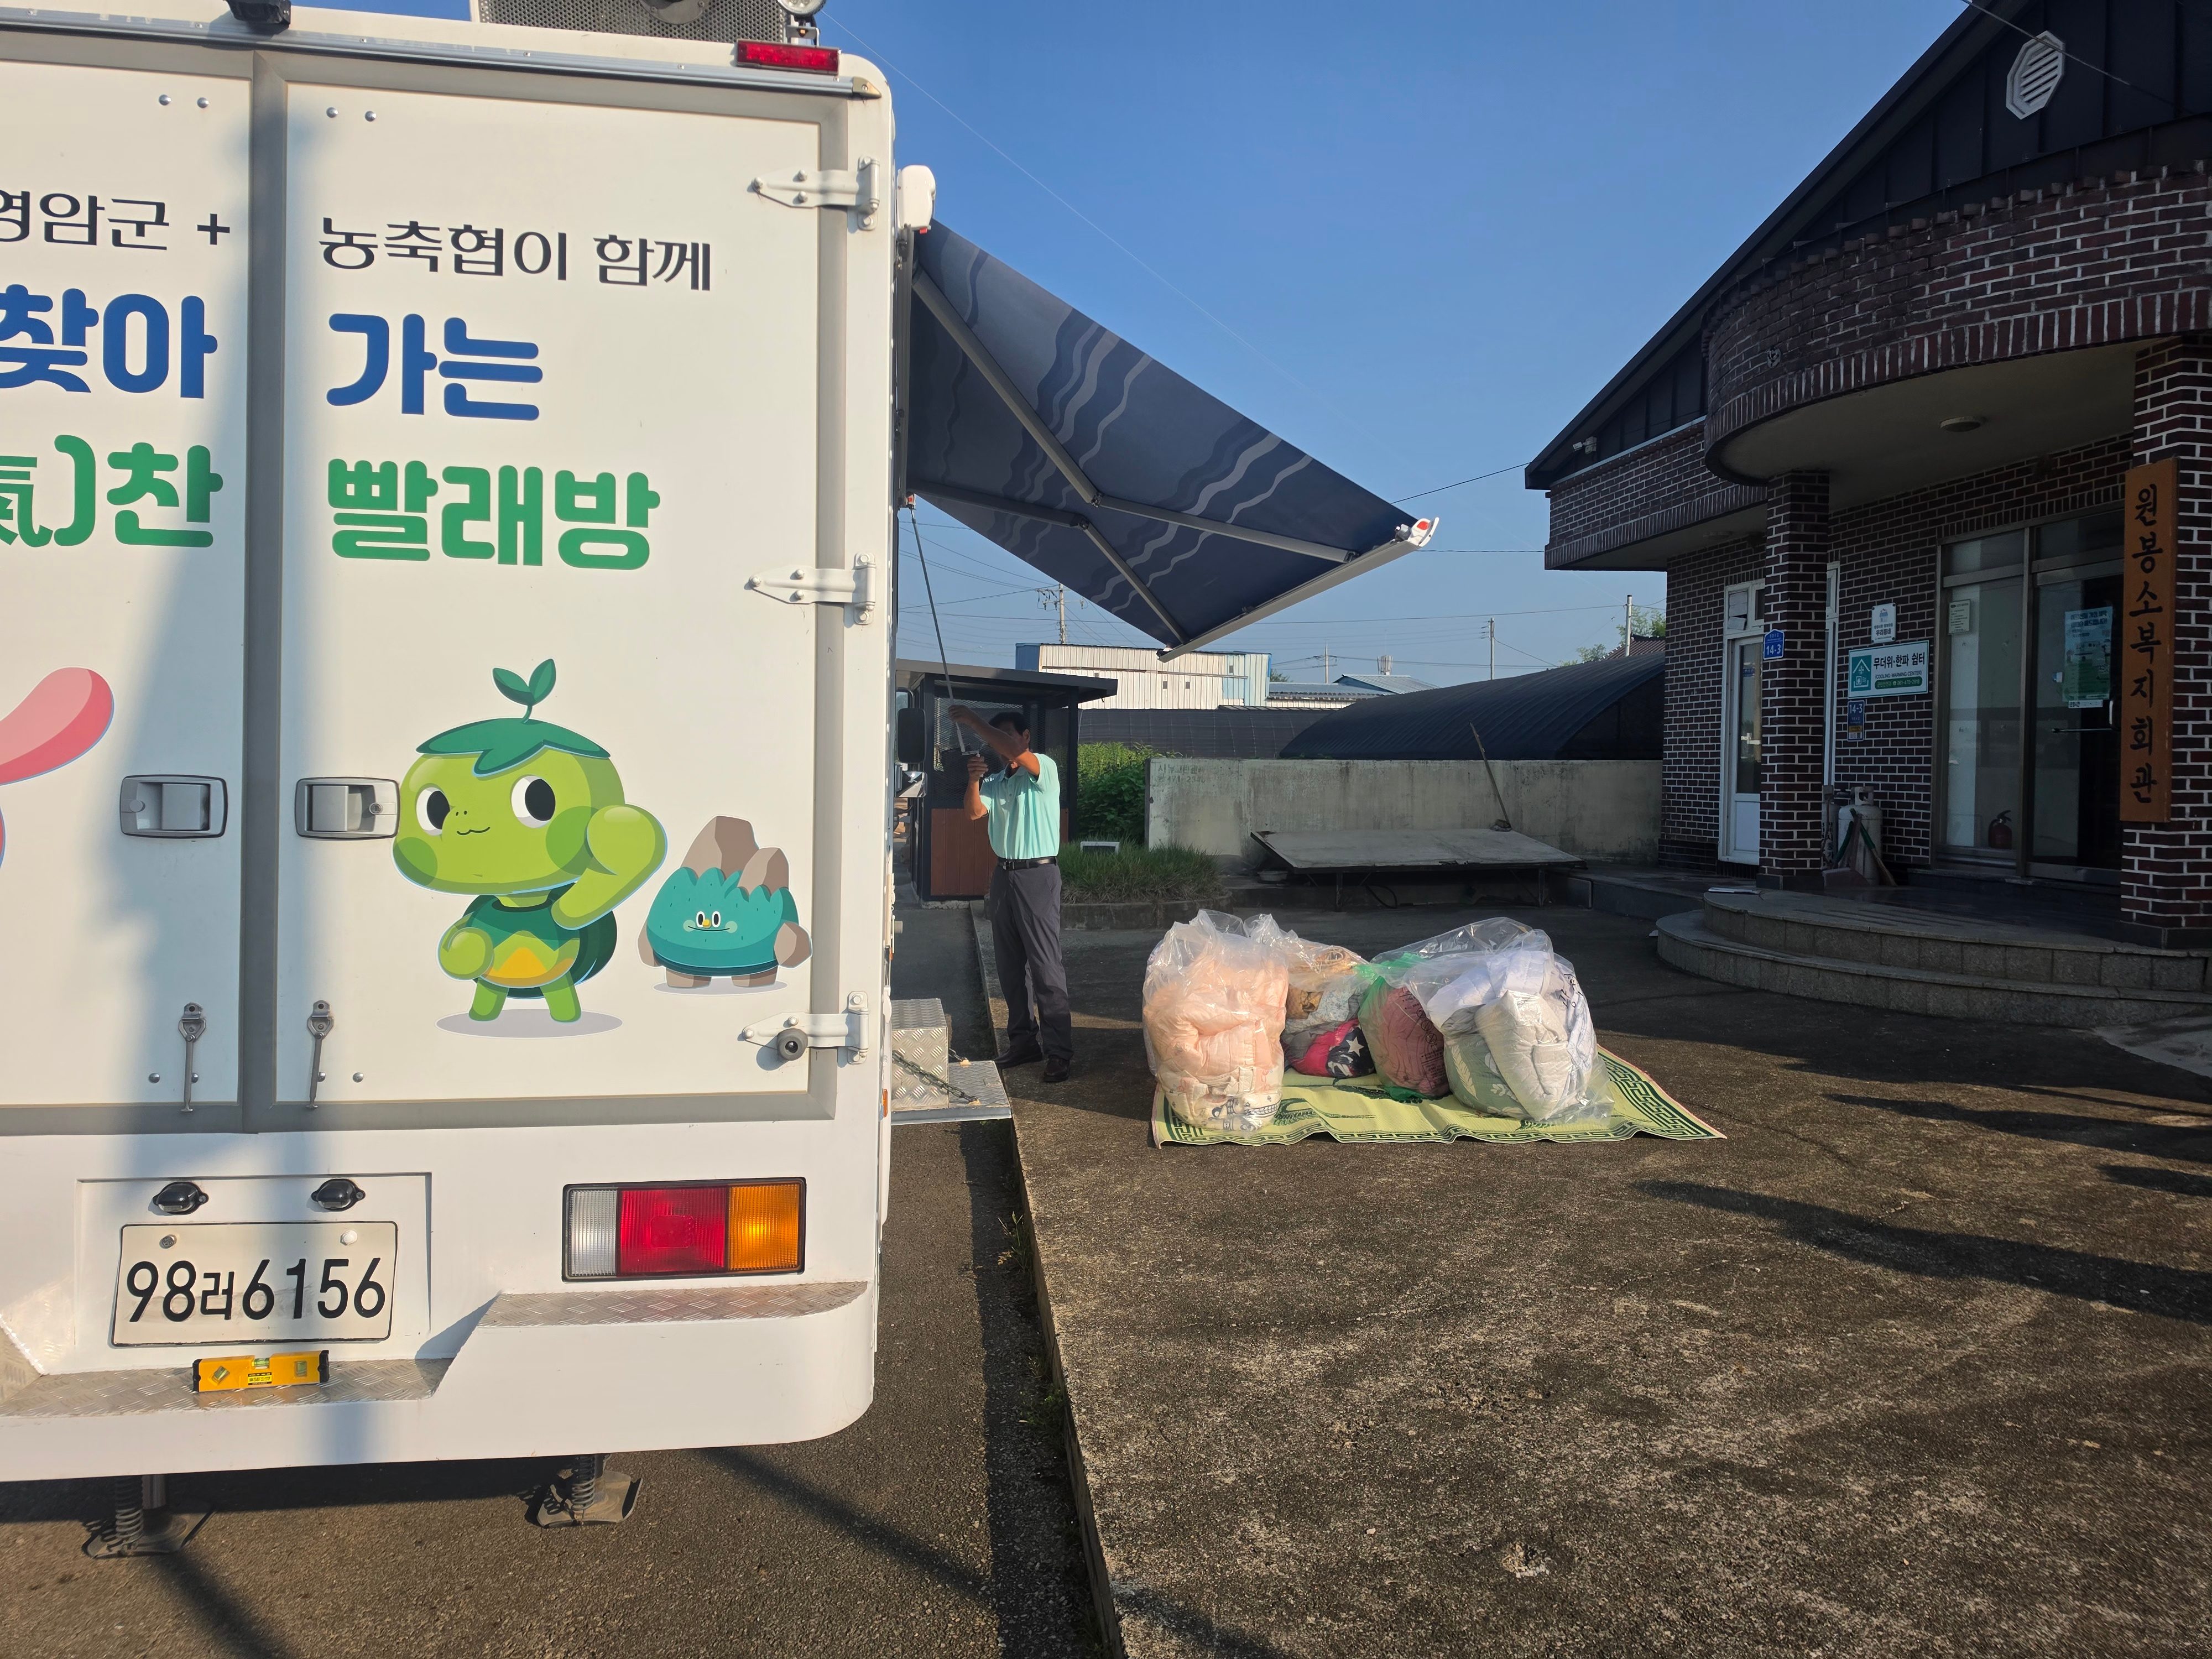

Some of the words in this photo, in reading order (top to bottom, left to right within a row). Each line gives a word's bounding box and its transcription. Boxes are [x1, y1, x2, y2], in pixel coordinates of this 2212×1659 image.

[0, 190, 169, 251] 영암군
[197, 213, 231, 246] +
[320, 217, 567, 281] 농축협이
[594, 234, 711, 291] 함께
[0, 284, 218, 399] 찾아
[326, 314, 543, 420] 가는
[328, 458, 660, 570] 빨래방
[1766, 644, 1781, 655] 14-3
[1874, 654, 1909, 669] 무더위·한파
[1912, 652, 1925, 665] 쉼터
[2129, 483, 2163, 803] 원봉소복지회관
[1849, 703, 1863, 714] 14-3
[127, 1258, 386, 1322] 98러6156
